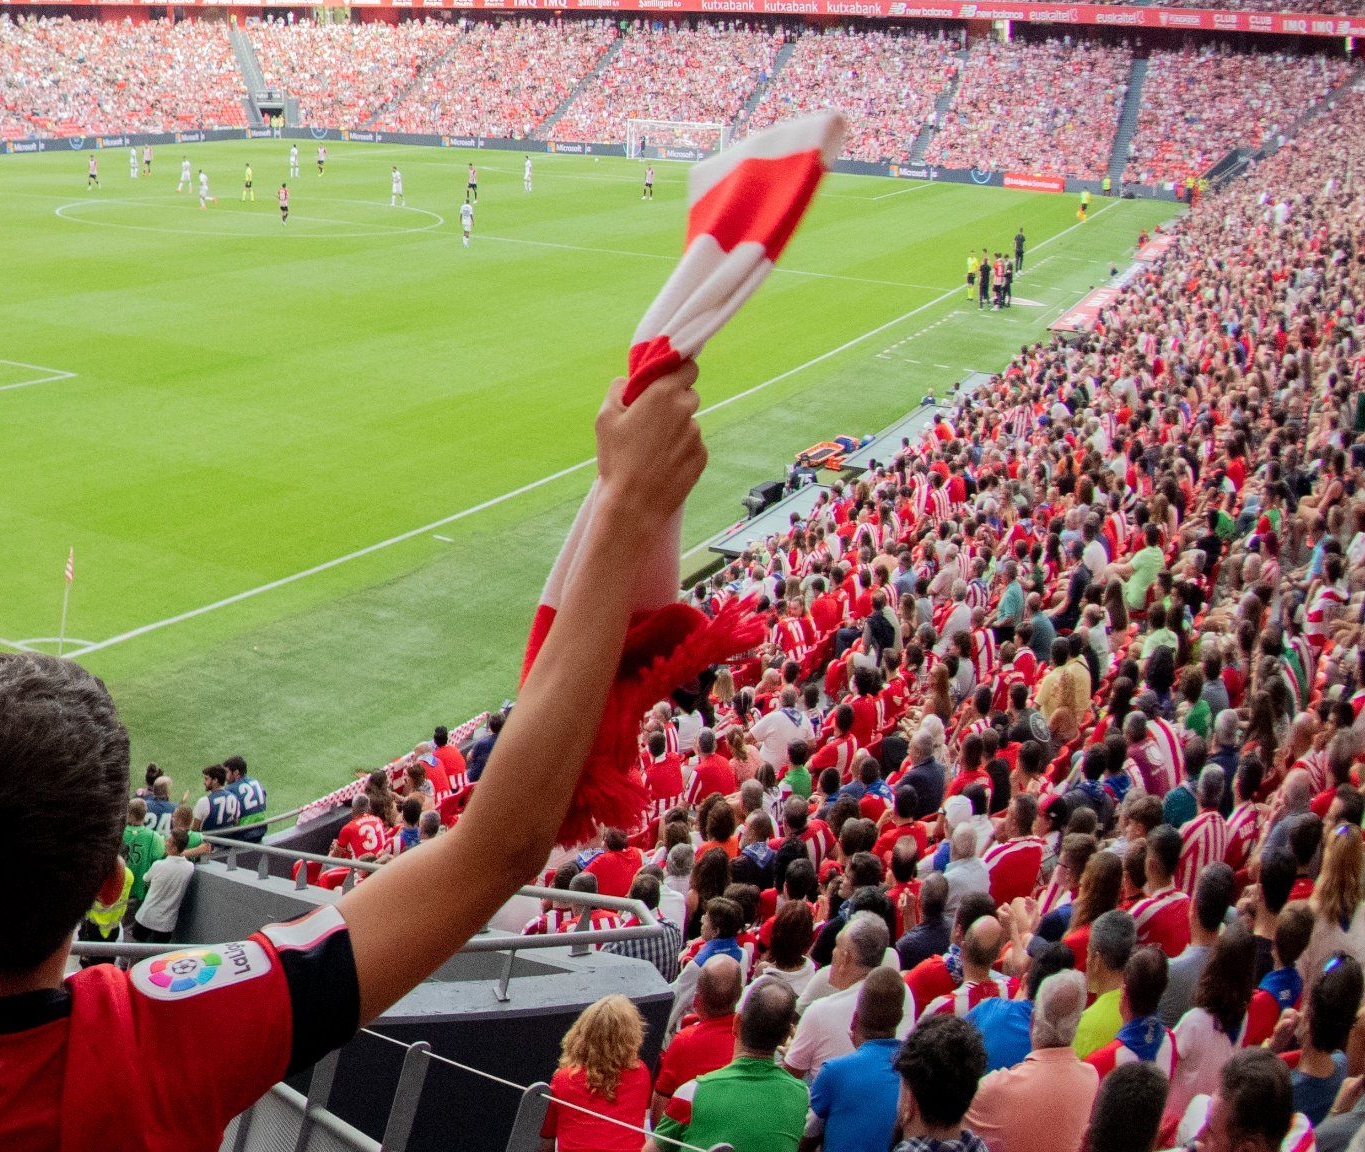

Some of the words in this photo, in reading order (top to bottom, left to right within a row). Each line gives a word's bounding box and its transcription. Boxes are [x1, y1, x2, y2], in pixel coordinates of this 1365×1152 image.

[701, 0, 754, 12] kutxabank
[765, 1, 818, 13] kutxabank
[827, 2, 880, 14] kutxabank
[1029, 10, 1070, 21] euskaltel
[1096, 12, 1137, 24] euskaltel
[1283, 20, 1307, 33] IMQ
[1312, 21, 1335, 35] IMQ
[450, 138, 476, 149] Microsoft
[556, 143, 581, 154] Microsoft
[899, 168, 928, 179] Microsoft
[214, 793, 237, 825] 79
